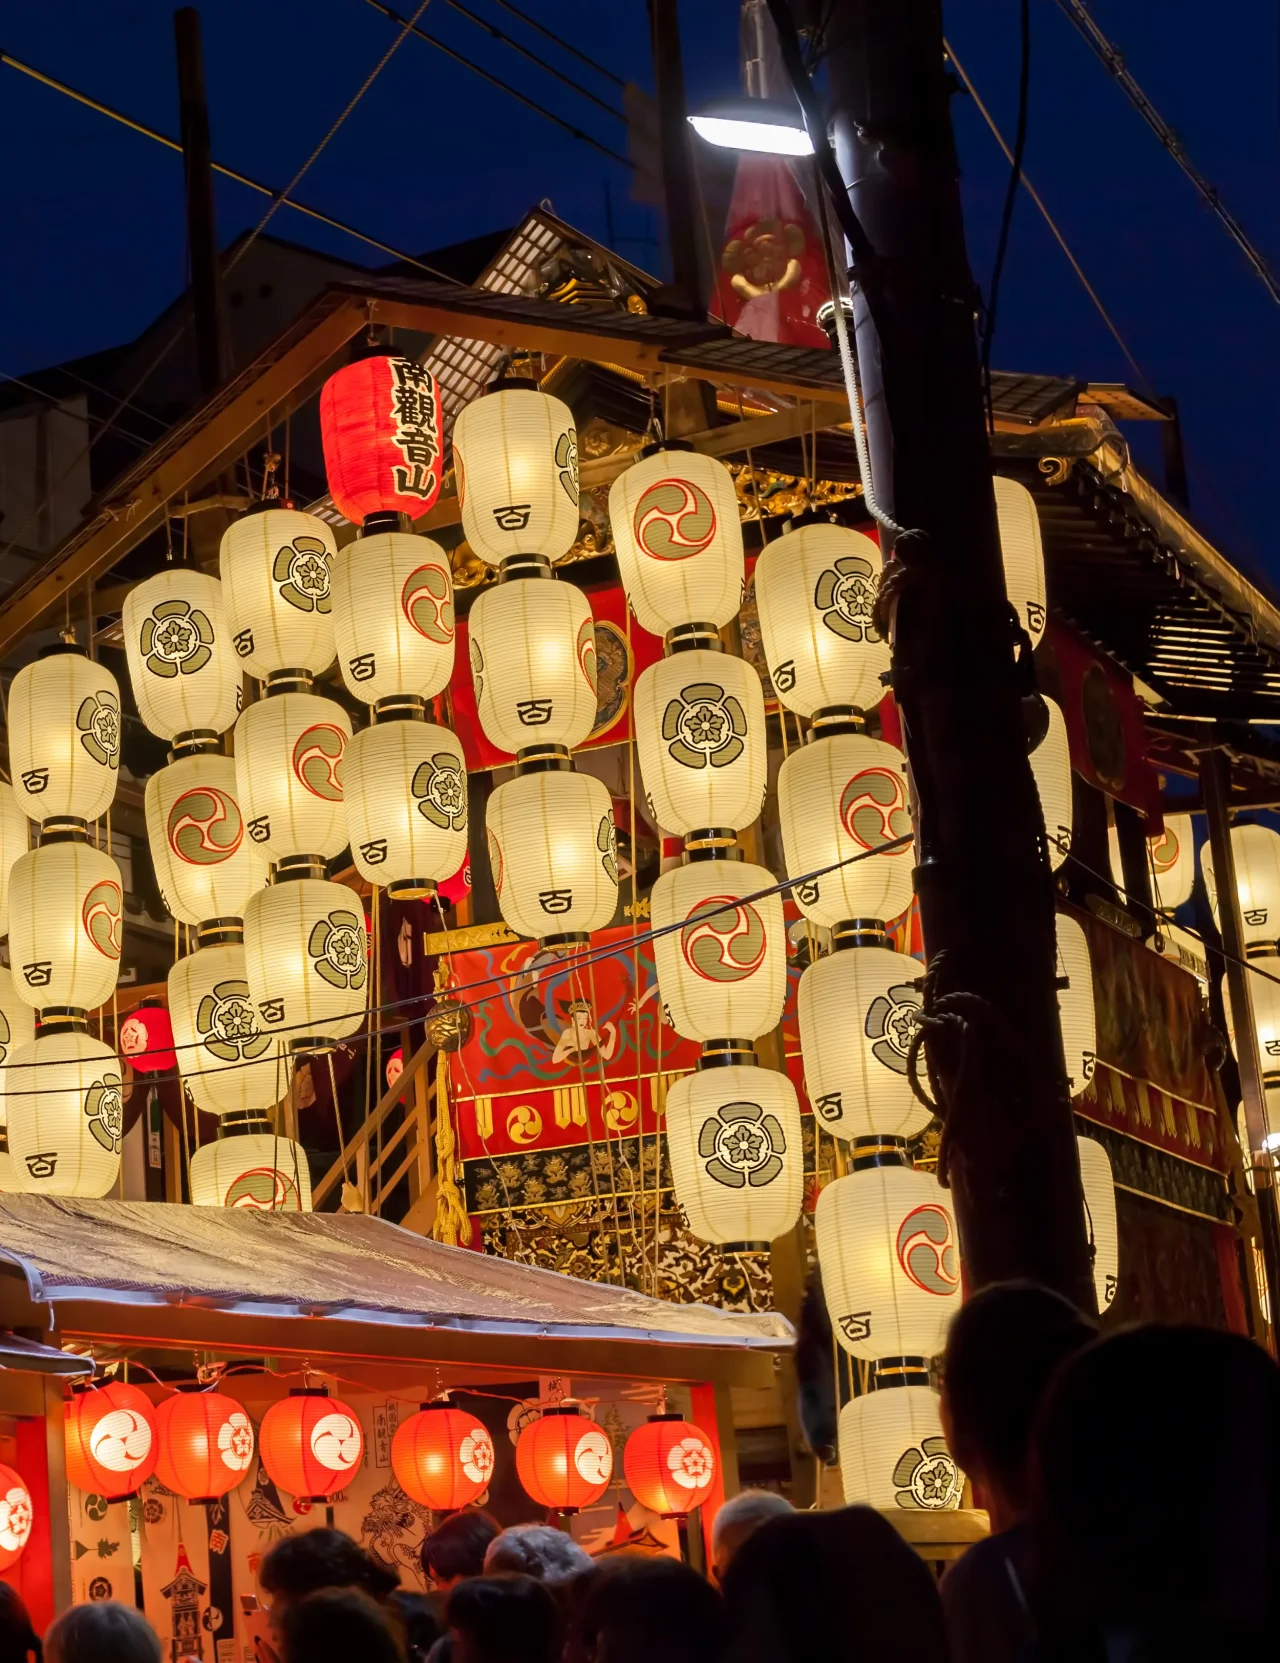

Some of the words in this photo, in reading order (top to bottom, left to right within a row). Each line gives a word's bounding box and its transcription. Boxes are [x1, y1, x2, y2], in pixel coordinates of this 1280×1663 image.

[390, 357, 438, 498] 南觀音山
[493, 504, 531, 531] 百
[232, 628, 255, 658] 百
[349, 653, 376, 682] 百
[773, 660, 795, 692] 百
[517, 698, 553, 725] 百
[22, 768, 49, 794] 百
[247, 815, 271, 843] 百
[359, 839, 387, 865] 百
[539, 889, 573, 914] 百
[1243, 908, 1268, 926] 百
[23, 961, 52, 987] 百
[258, 998, 285, 1023] 百
[815, 1092, 843, 1122] 百
[26, 1152, 57, 1178] 百
[838, 1311, 872, 1342] 百
